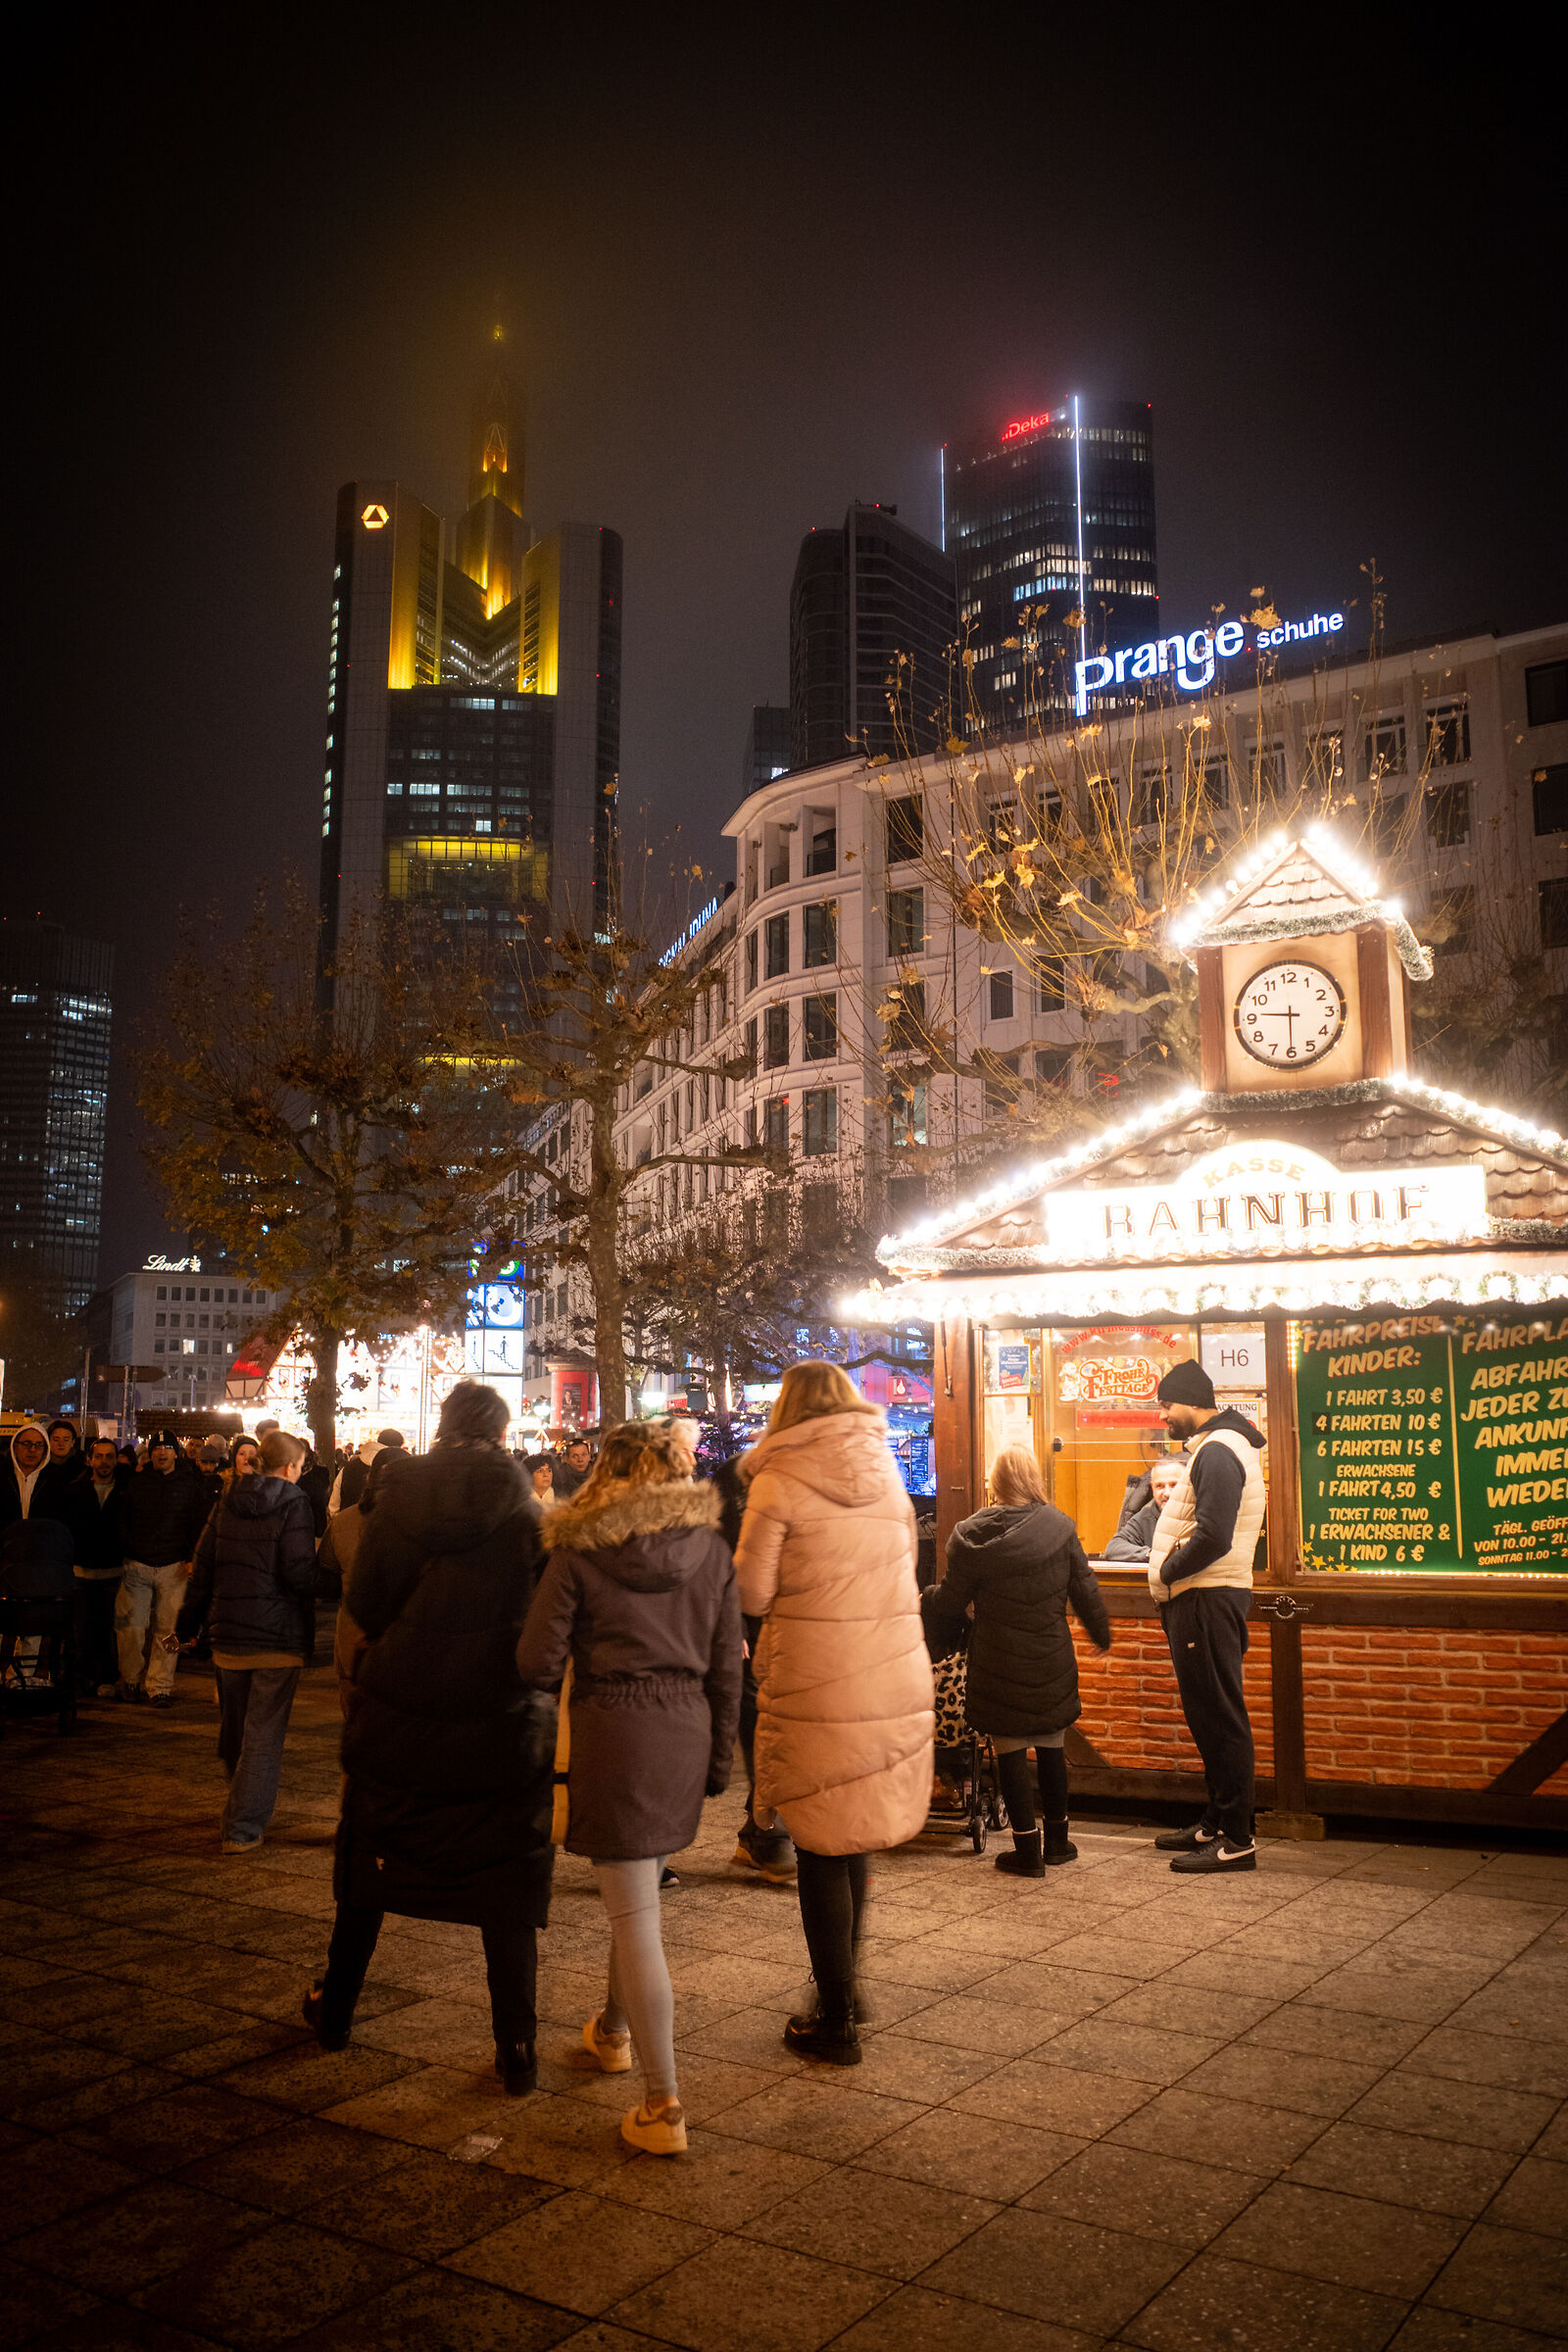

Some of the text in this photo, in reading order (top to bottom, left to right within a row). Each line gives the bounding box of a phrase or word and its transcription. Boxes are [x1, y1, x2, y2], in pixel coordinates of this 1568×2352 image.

[1007, 412, 1050, 439] Deka
[1256, 612, 1344, 649] schuhe
[1264, 980, 1276, 992] 11
[1280, 972, 1297, 984] 12
[1304, 977, 1309, 988] 1
[1252, 994, 1268, 1006] 10
[1316, 990, 1326, 1001] 2
[1247, 1013, 1257, 1025] 9
[1325, 1005, 1335, 1017] 3
[1252, 1031, 1264, 1043] 8
[1318, 1025, 1329, 1037] 4
[1268, 1044, 1278, 1055] 7
[1286, 1047, 1298, 1058] 6
[1305, 1040, 1316, 1053] 5
[1203, 1157, 1305, 1189] KASSE
[142, 1254, 190, 1272] Lindt
[1221, 1348, 1249, 1367] H6
[1328, 1346, 1421, 1378] KINDER:
[1099, 1359, 1150, 1384] FROHE
[1080, 1362, 1156, 1399] FESTTAGE
[1326, 1387, 1444, 1407] 1 FAHRT 3,50 €
[1460, 1391, 1541, 1422] JEDER
[1315, 1412, 1442, 1431] 4 FAHRTEN 10 €
[1317, 1438, 1442, 1457] 6 FAHRTEN 15 €
[1336, 1463, 1416, 1478] ERWACHSENE
[1318, 1480, 1442, 1500] 1 FAHRT 4,50 €
[1487, 1476, 1568, 1508] WIEDE
[1328, 1507, 1429, 1521] TICKET FOR TWO
[1309, 1523, 1450, 1541] 1 ERWACHSENER &
[1493, 1520, 1528, 1536] TÄGL.
[1473, 1540, 1500, 1552] VON
[1502, 1535, 1537, 1549] 10.00
[1340, 1544, 1425, 1562] 1 KIND 6 €
[1478, 1553, 1523, 1566] SONNTAG
[1525, 1549, 1549, 1561] 11.00
